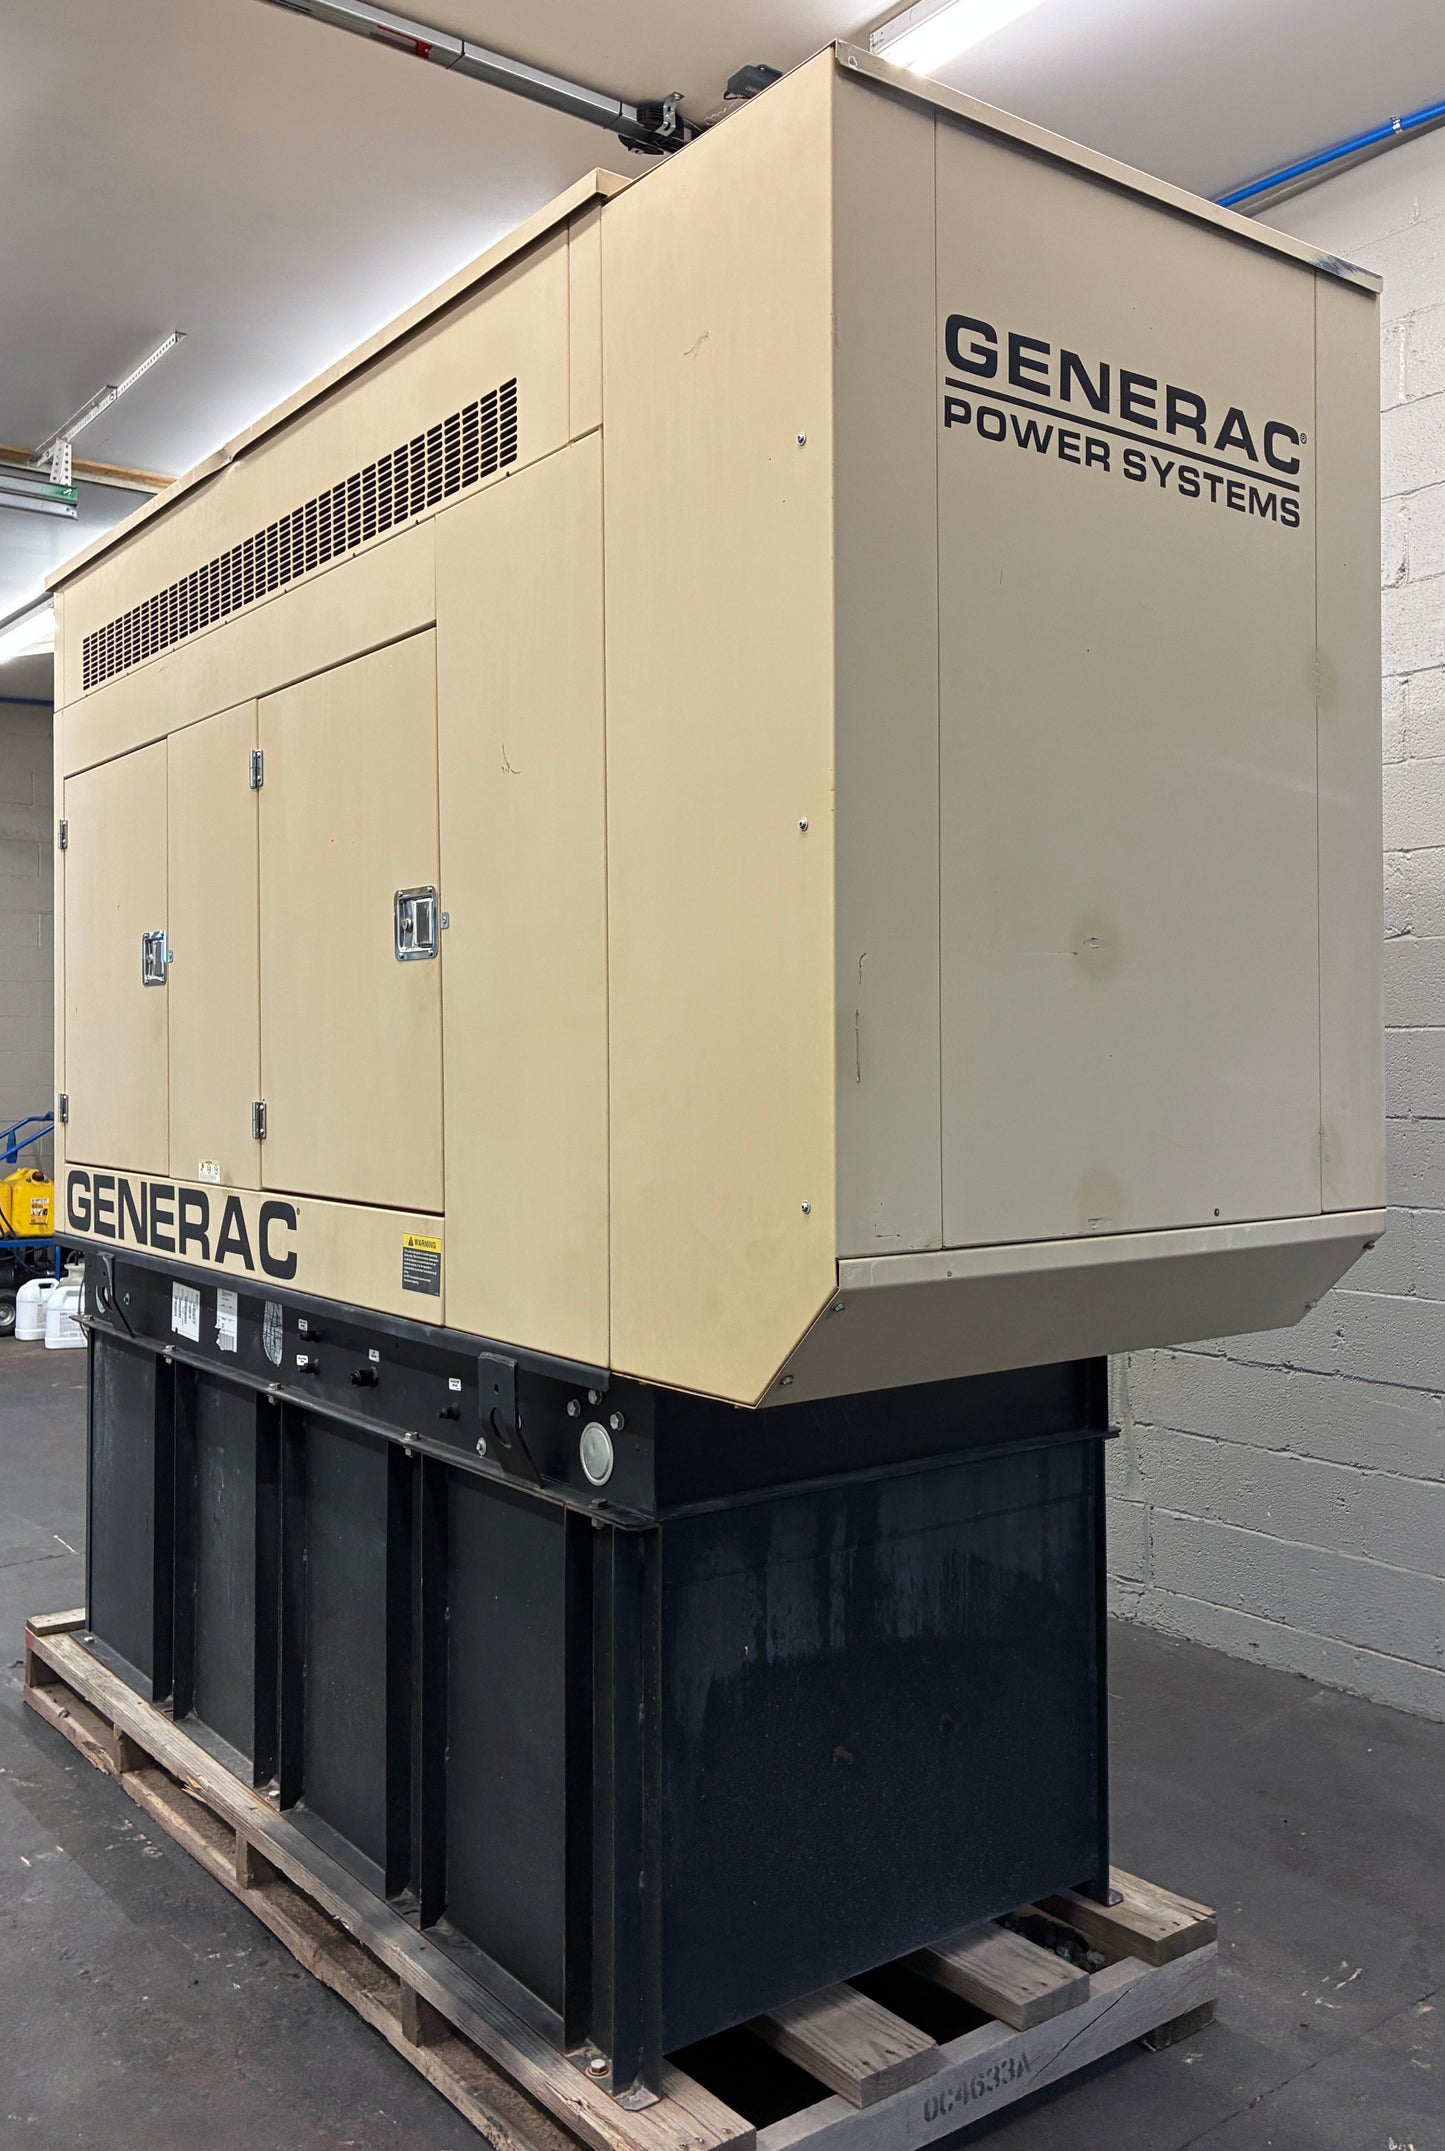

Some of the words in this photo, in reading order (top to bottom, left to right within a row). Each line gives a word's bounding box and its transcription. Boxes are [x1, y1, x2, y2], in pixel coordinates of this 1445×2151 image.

[945, 314, 1300, 475] GENERAC
[944, 395, 1110, 472] POWER
[1123, 448, 1300, 528] SYSTEMS
[67, 1170, 298, 1280] GENERAC
[414, 1239, 437, 1249] WARNING
